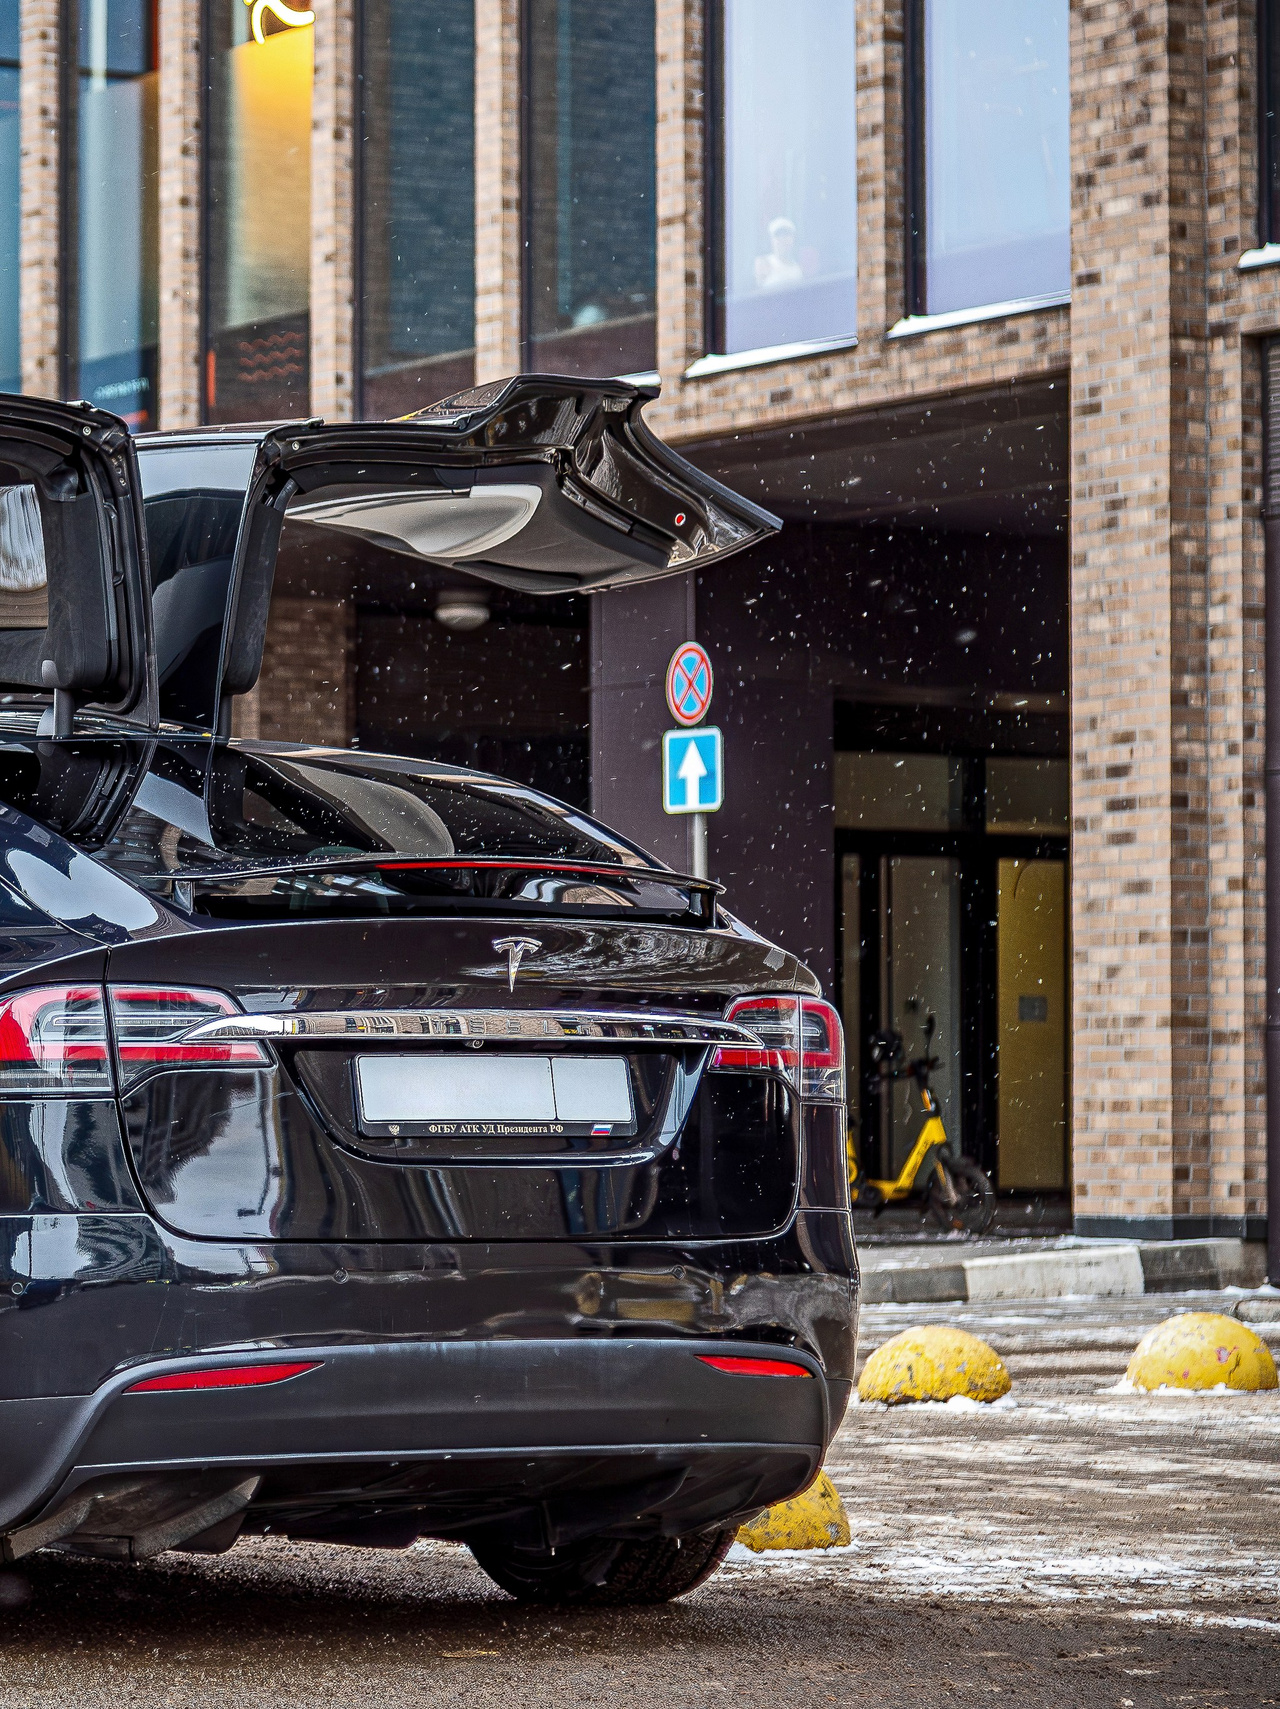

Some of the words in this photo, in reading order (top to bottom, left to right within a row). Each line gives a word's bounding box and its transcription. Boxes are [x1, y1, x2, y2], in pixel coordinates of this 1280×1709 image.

[428, 1124, 457, 1134] ФГБУ
[460, 1124, 480, 1134] АТК
[481, 1124, 495, 1135] УД
[497, 1124, 548, 1135] Президента
[550, 1124, 564, 1134] РФ
